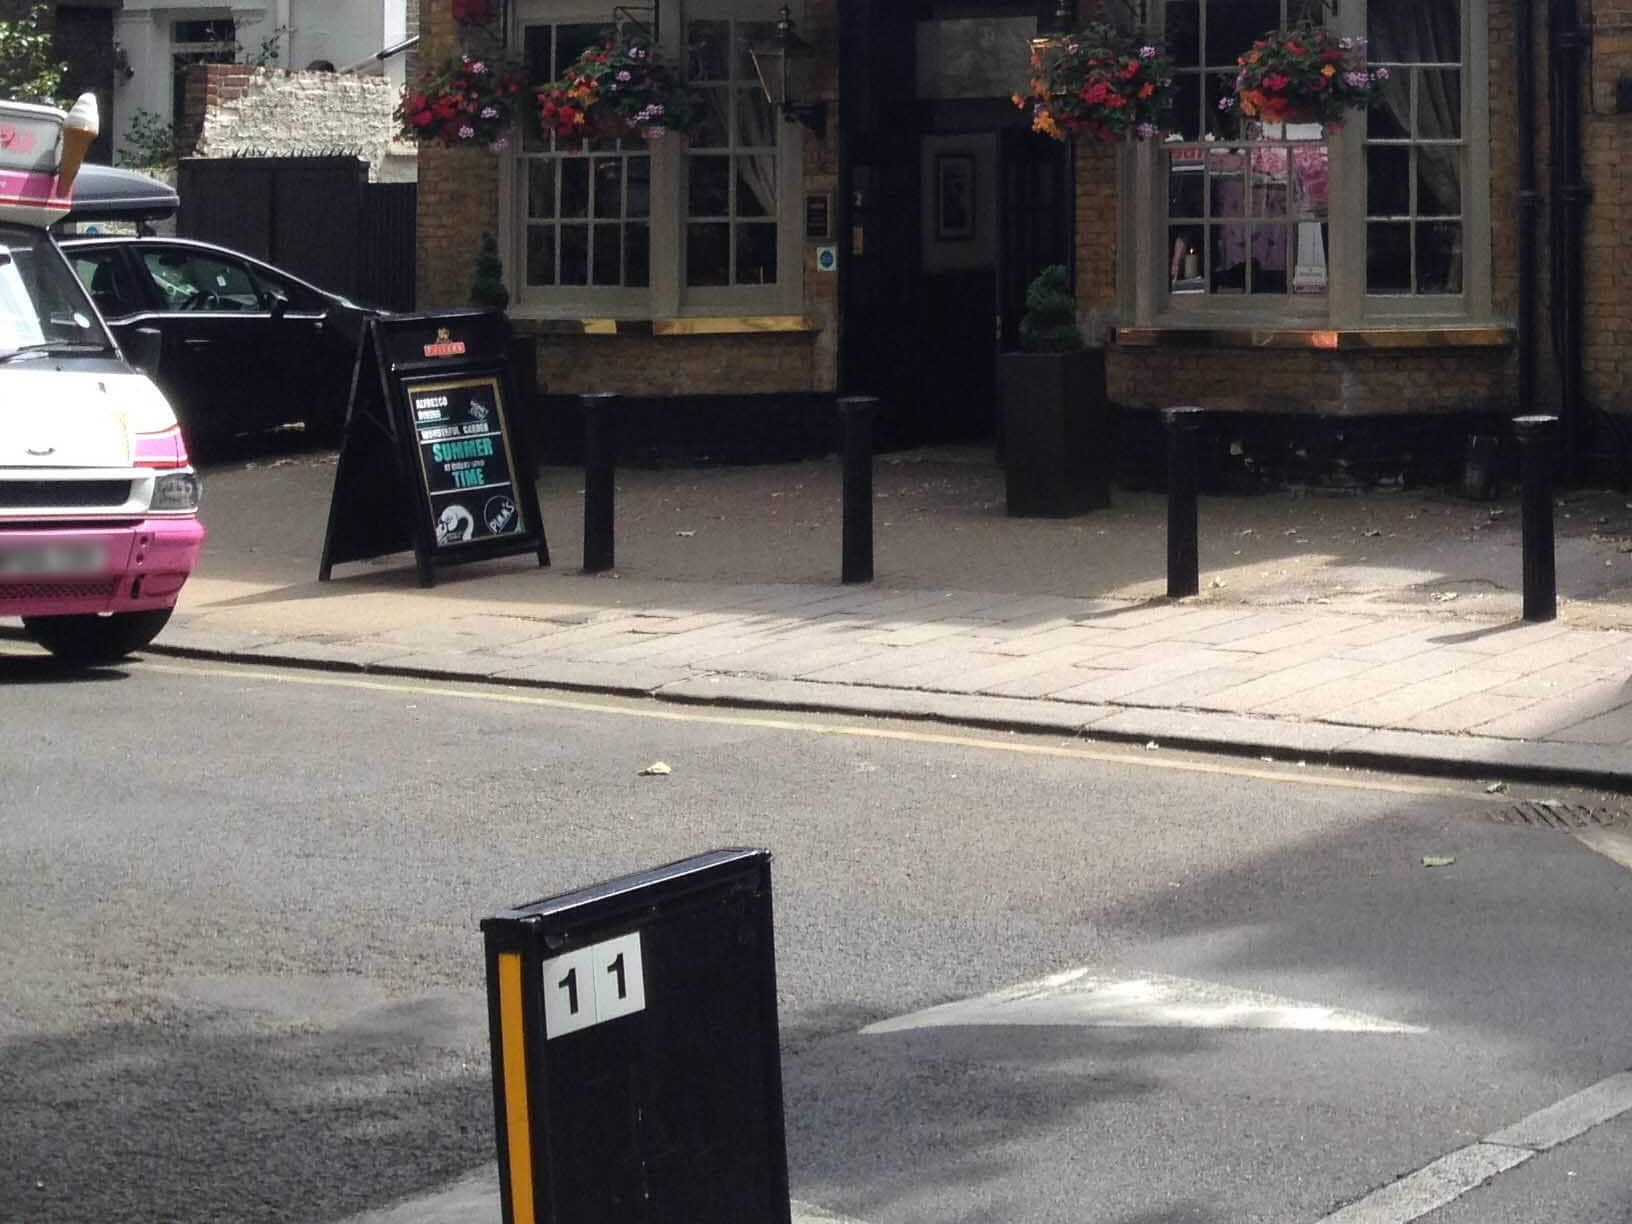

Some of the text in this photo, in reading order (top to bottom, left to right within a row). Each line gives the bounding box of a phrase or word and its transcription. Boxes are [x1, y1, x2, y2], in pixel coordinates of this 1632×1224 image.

[432, 438, 494, 462] SUMMER
[452, 468, 485, 488] TIME
[558, 952, 627, 1016] 11
